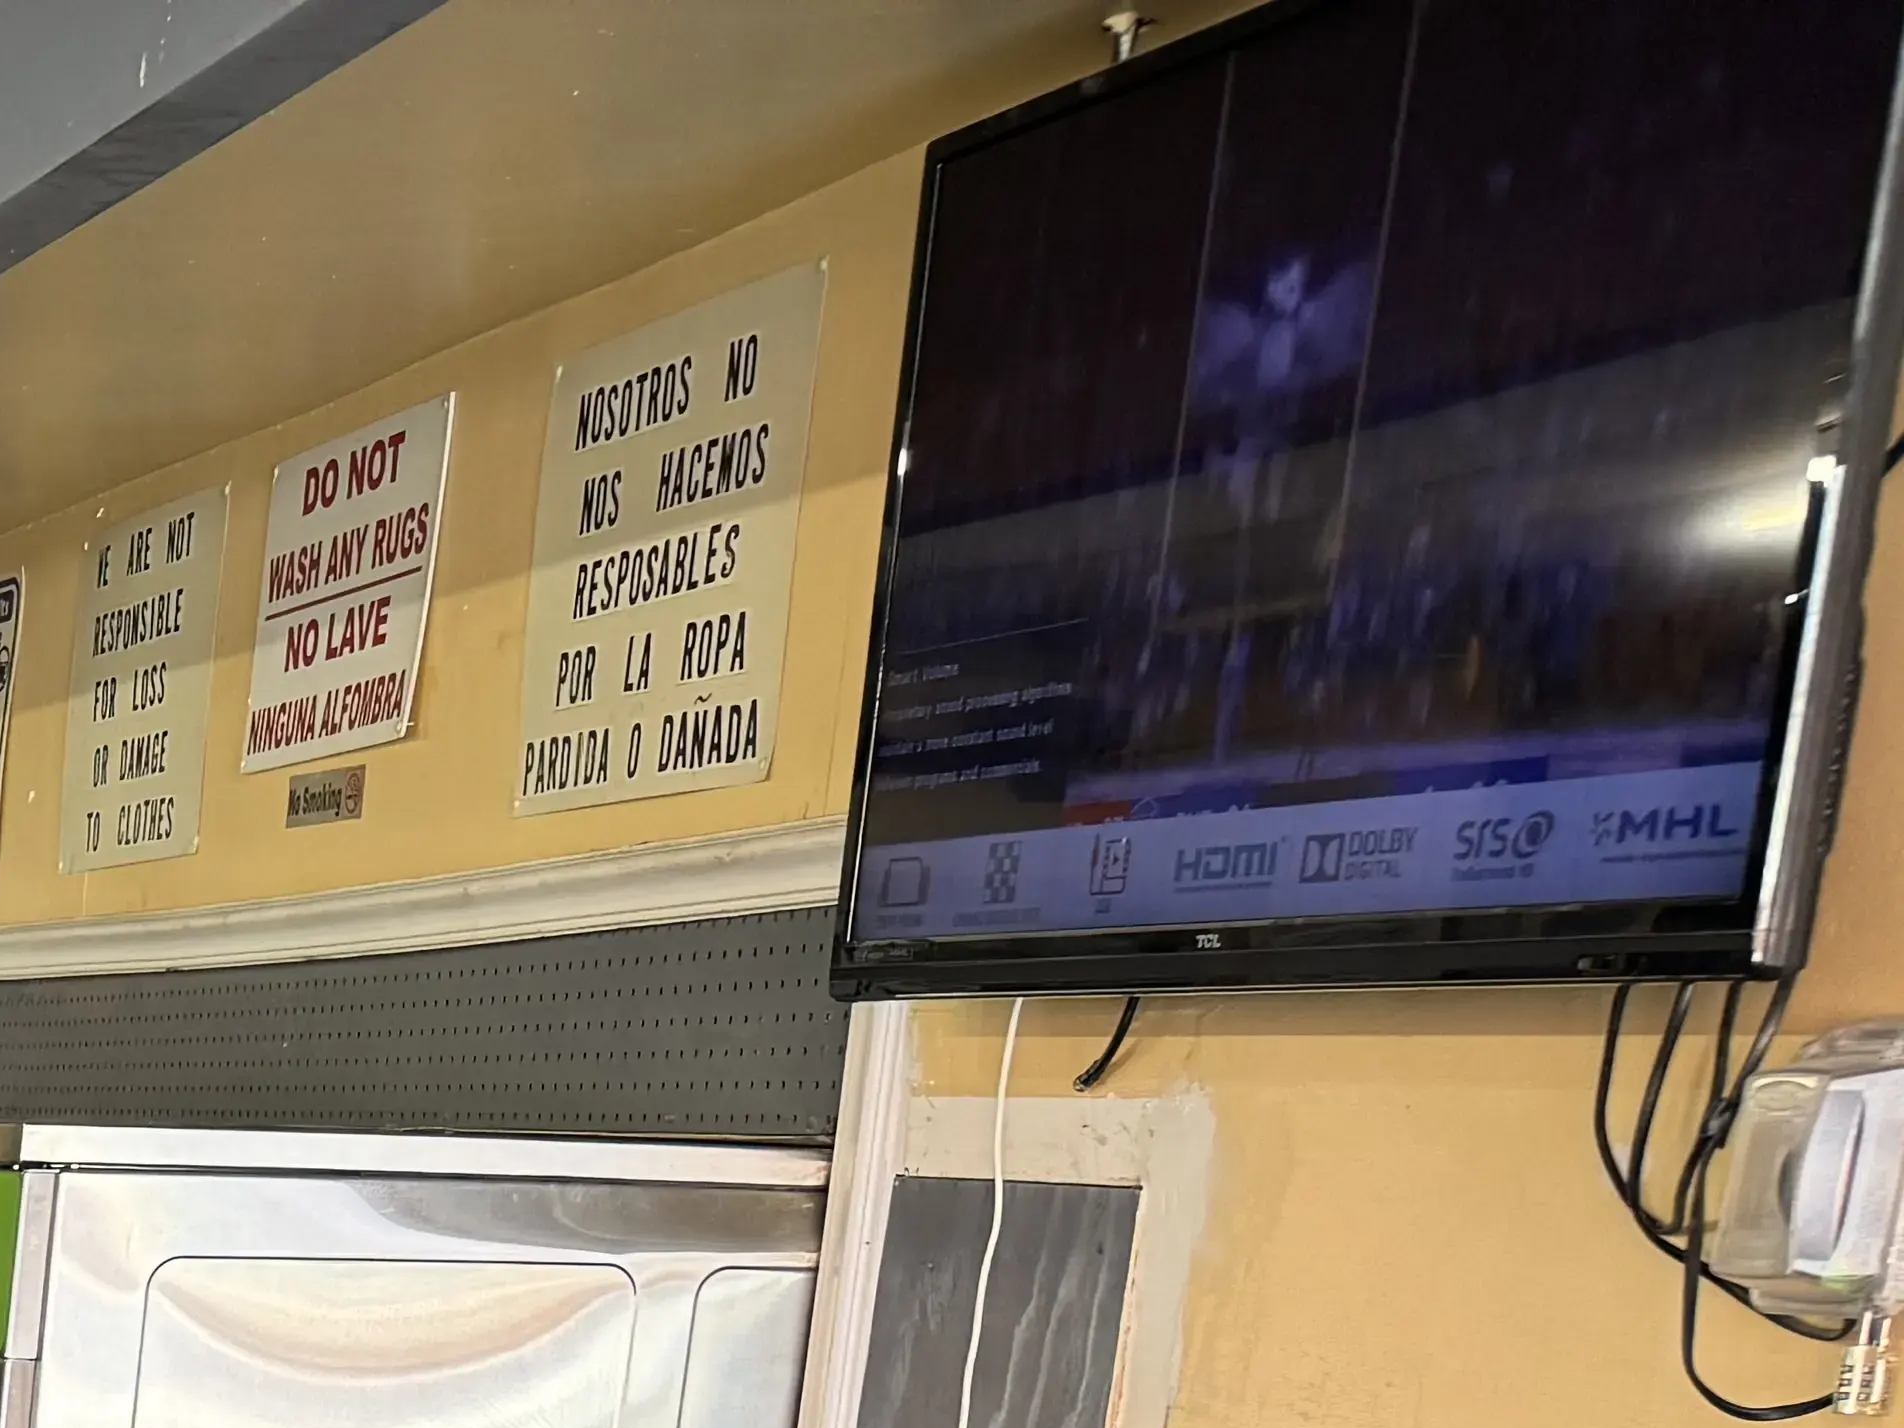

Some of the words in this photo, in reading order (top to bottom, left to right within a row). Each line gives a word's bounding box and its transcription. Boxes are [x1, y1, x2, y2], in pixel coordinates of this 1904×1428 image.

[575, 356, 692, 451] NOSOTROS
[725, 334, 758, 402] NO
[302, 459, 339, 516] DO
[346, 430, 406, 500] NOT
[579, 470, 622, 536] NOS
[656, 424, 769, 512] HACEMOS
[126, 527, 153, 576] ARE
[165, 511, 195, 564] NOT
[269, 540, 323, 603] WASH
[324, 524, 369, 585] ANY
[371, 502, 429, 569] RUGS
[573, 523, 740, 620] RESPOSABLES
[92, 588, 184, 658] RESPONSIBLE
[284, 619, 319, 673] NO
[325, 595, 391, 661] LAVE
[93, 677, 117, 722] FOR
[132, 661, 167, 711] LOSS
[556, 646, 597, 707] POR
[623, 633, 652, 692] LA
[680, 611, 746, 681] ROPA
[247, 695, 317, 756] NINGUNA
[318, 669, 406, 738] ALFOMBRA
[523, 727, 609, 796] PARDIDA
[627, 723, 641, 779] O
[657, 692, 758, 772] DAÑADA
[93, 744, 109, 788] OR
[119, 730, 169, 781] DAMAGE
[86, 811, 100, 852] TO
[117, 797, 174, 846] CLOTHES
[303, 783, 343, 817] Smoking
[1615, 805, 1740, 845] MHL
[1173, 840, 1279, 882] HDMI
[1344, 858, 1402, 880] DIGITAL
[1348, 826, 1419, 857] DOLBY
[1195, 934, 1222, 949] TCL
